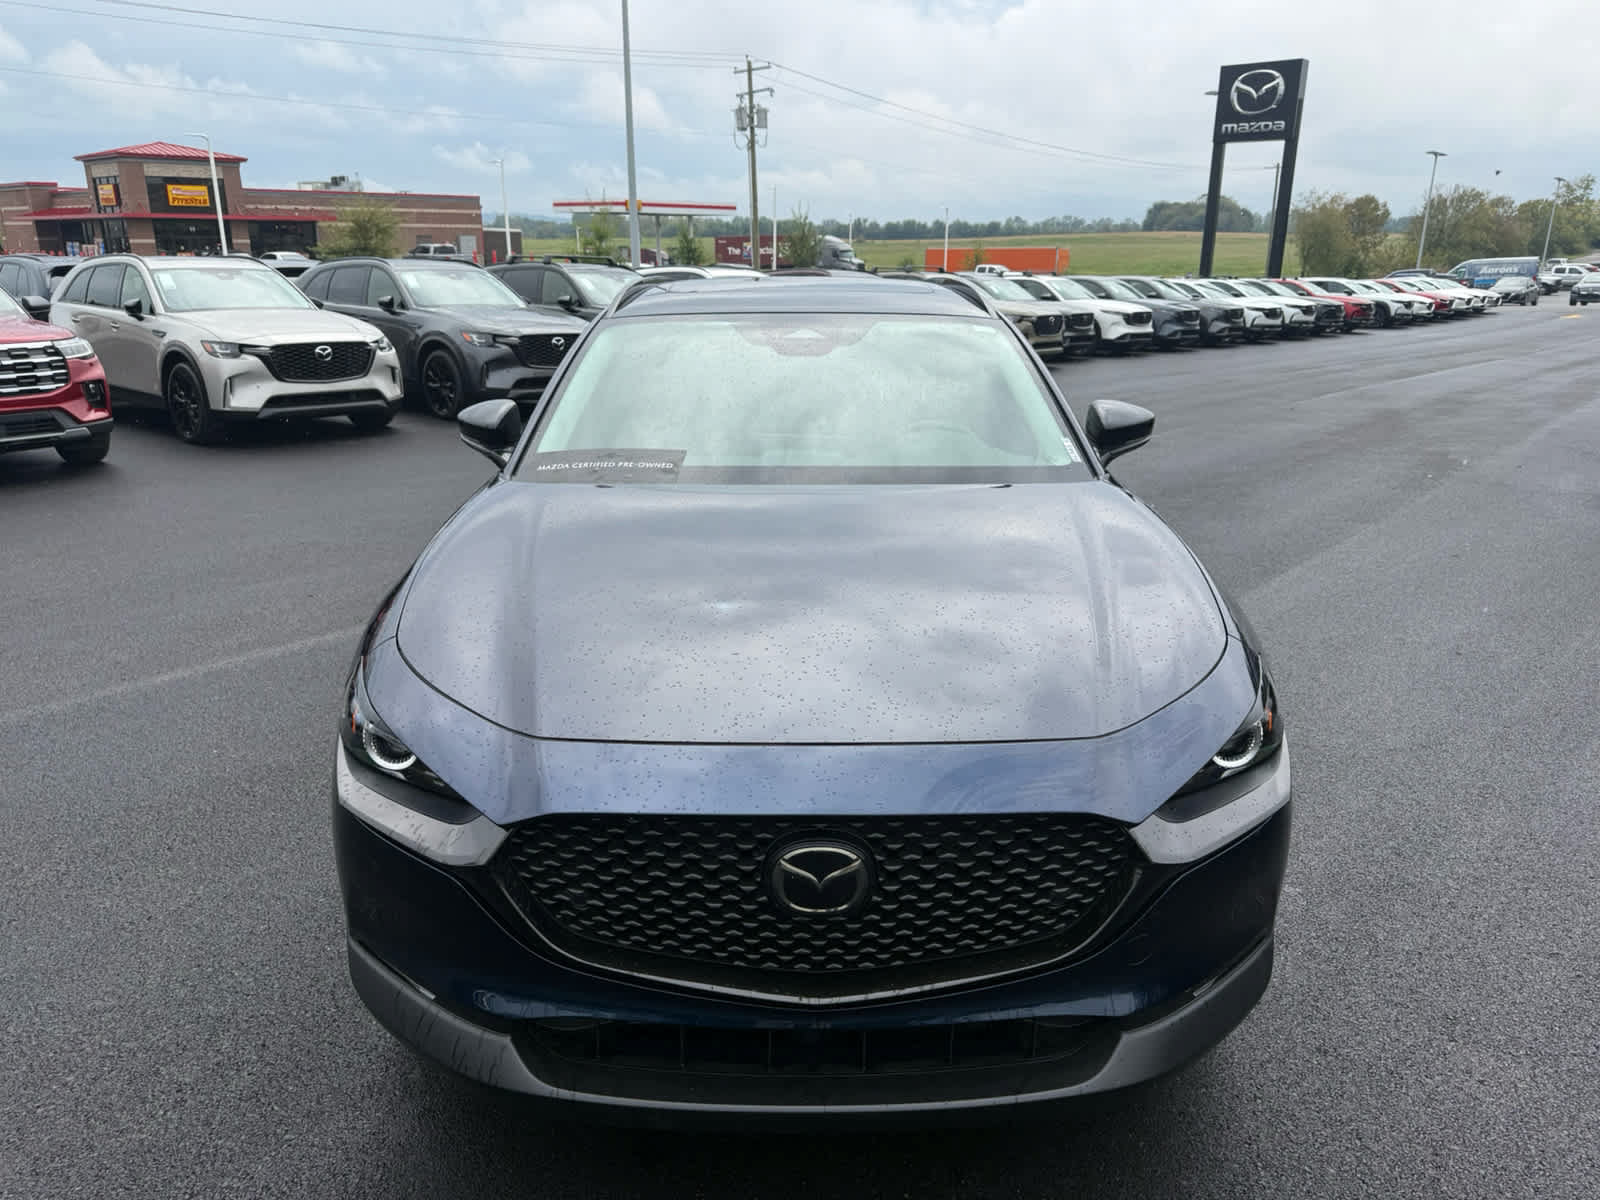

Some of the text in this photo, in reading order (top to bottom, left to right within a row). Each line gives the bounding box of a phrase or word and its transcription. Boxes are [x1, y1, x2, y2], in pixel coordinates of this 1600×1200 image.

[1222, 121, 1285, 133] mazda
[728, 247, 741, 255] The
[537, 463, 570, 471] MAZDA
[618, 461, 674, 469] PRE-OWNED
